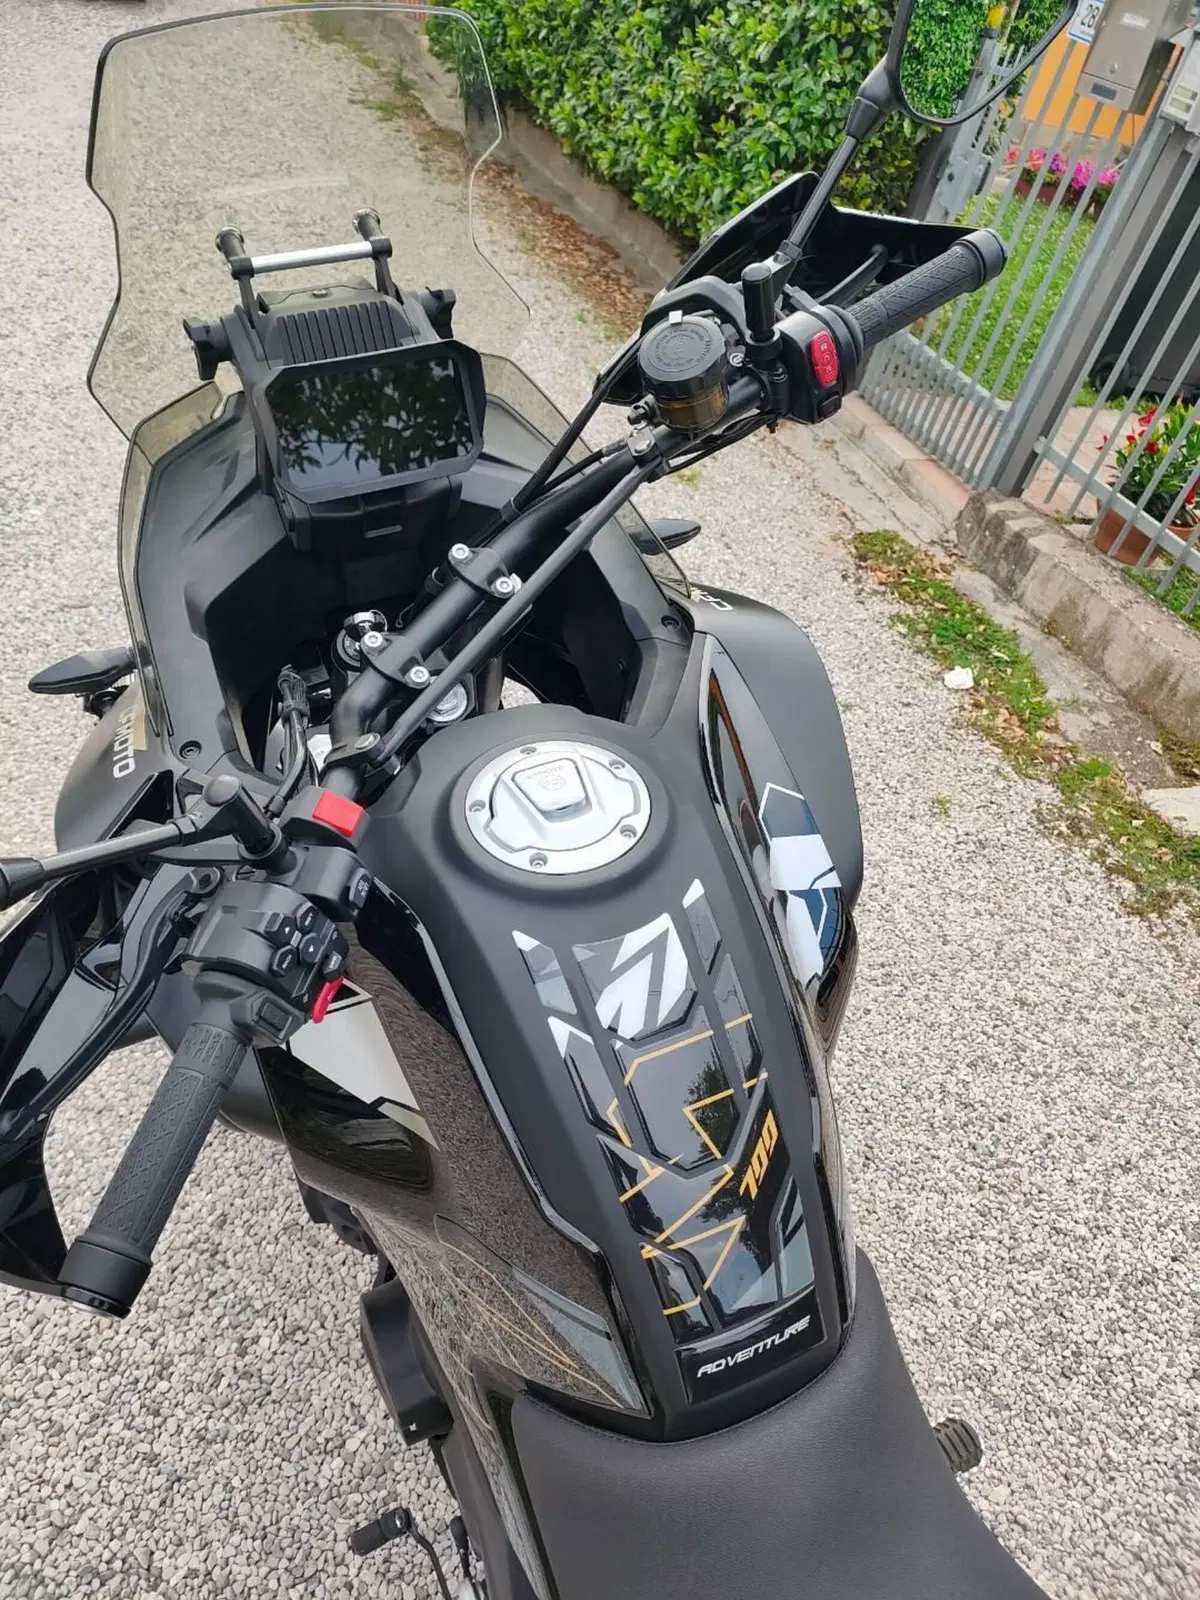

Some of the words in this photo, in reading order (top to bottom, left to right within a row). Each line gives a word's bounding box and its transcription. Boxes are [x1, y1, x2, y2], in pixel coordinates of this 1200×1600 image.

[1080, 4, 1099, 28] 28
[739, 1109, 778, 1200] 700
[697, 1315, 810, 1377] ADVENTURE
